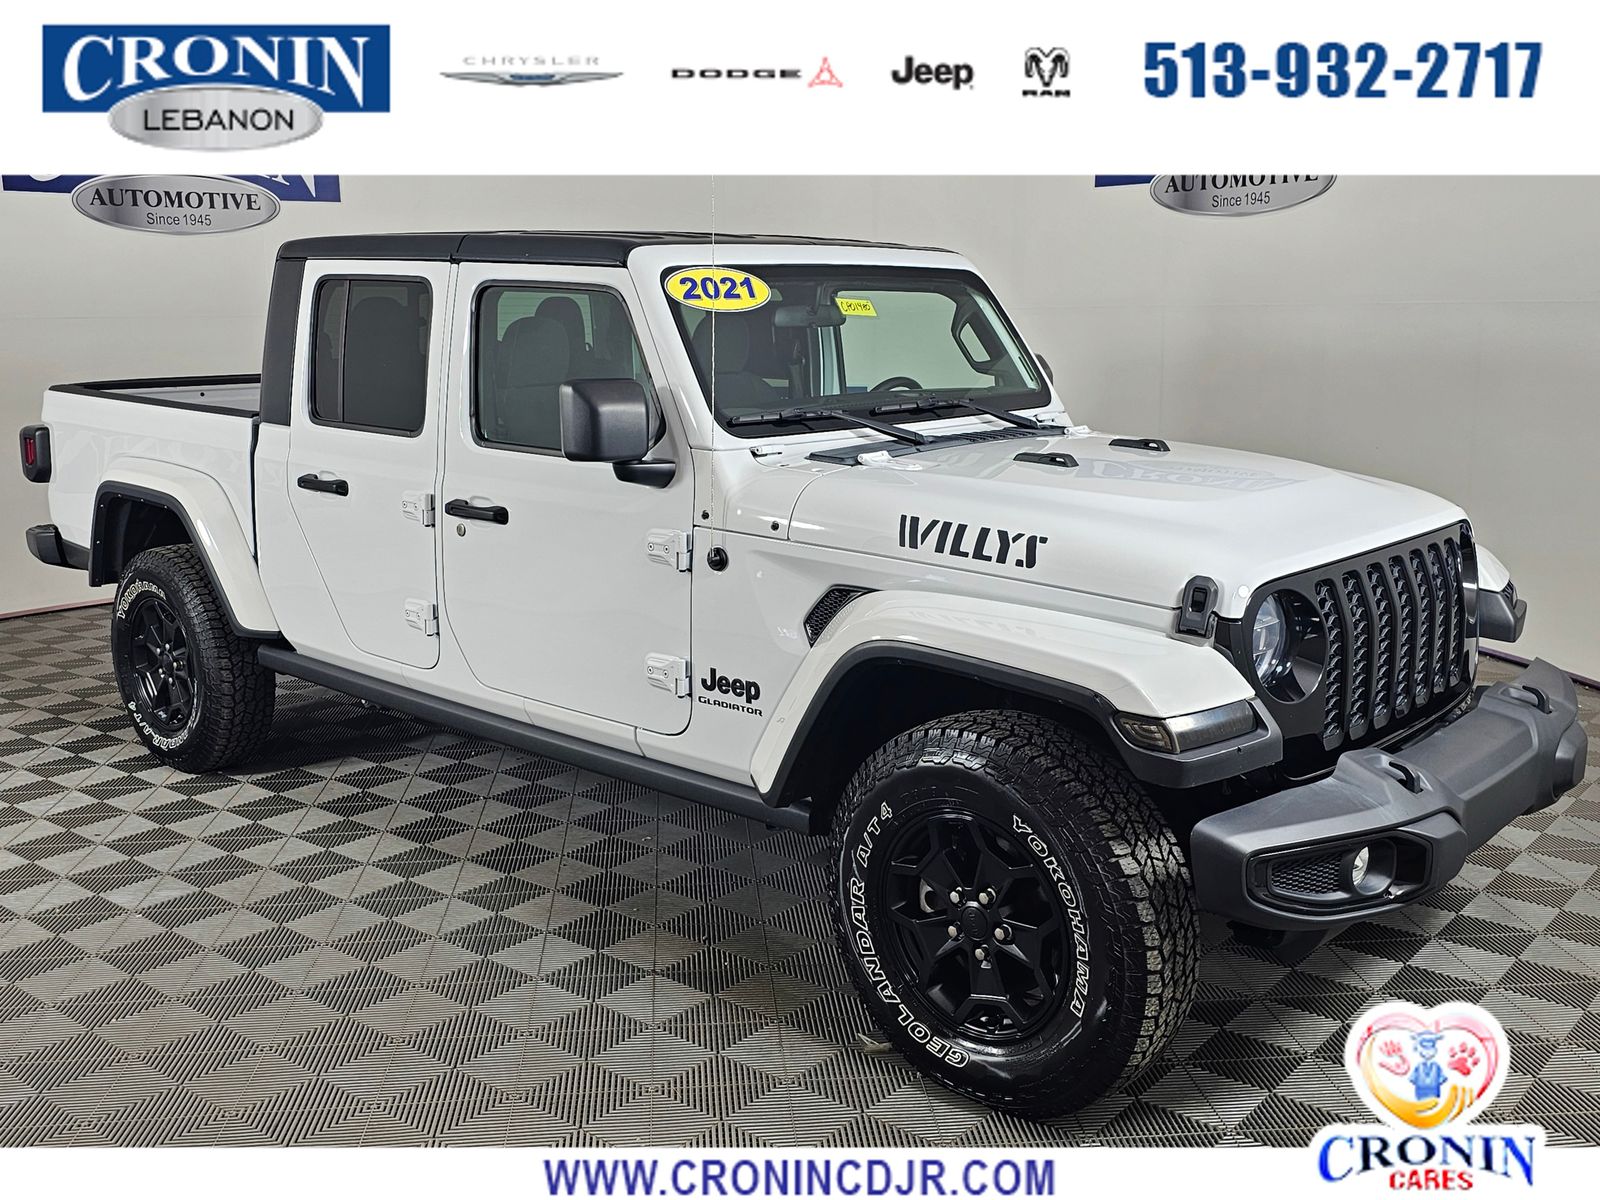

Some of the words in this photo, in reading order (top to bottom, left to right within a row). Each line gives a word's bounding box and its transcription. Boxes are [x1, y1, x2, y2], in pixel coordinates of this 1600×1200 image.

[89, 187, 261, 211] AUTOMOTIVE
[1211, 193, 1242, 208] Since
[1244, 190, 1271, 205] 1945
[146, 212, 180, 226] Since
[182, 213, 212, 227] 1945
[679, 276, 756, 300] 2021
[899, 514, 1048, 569] WILLYS
[700, 667, 761, 704] Jeep
[698, 695, 763, 717] GLADIATOR
[1011, 813, 1090, 1018] YOKOHAMA
[849, 876, 971, 1068] GEOLANDAR
